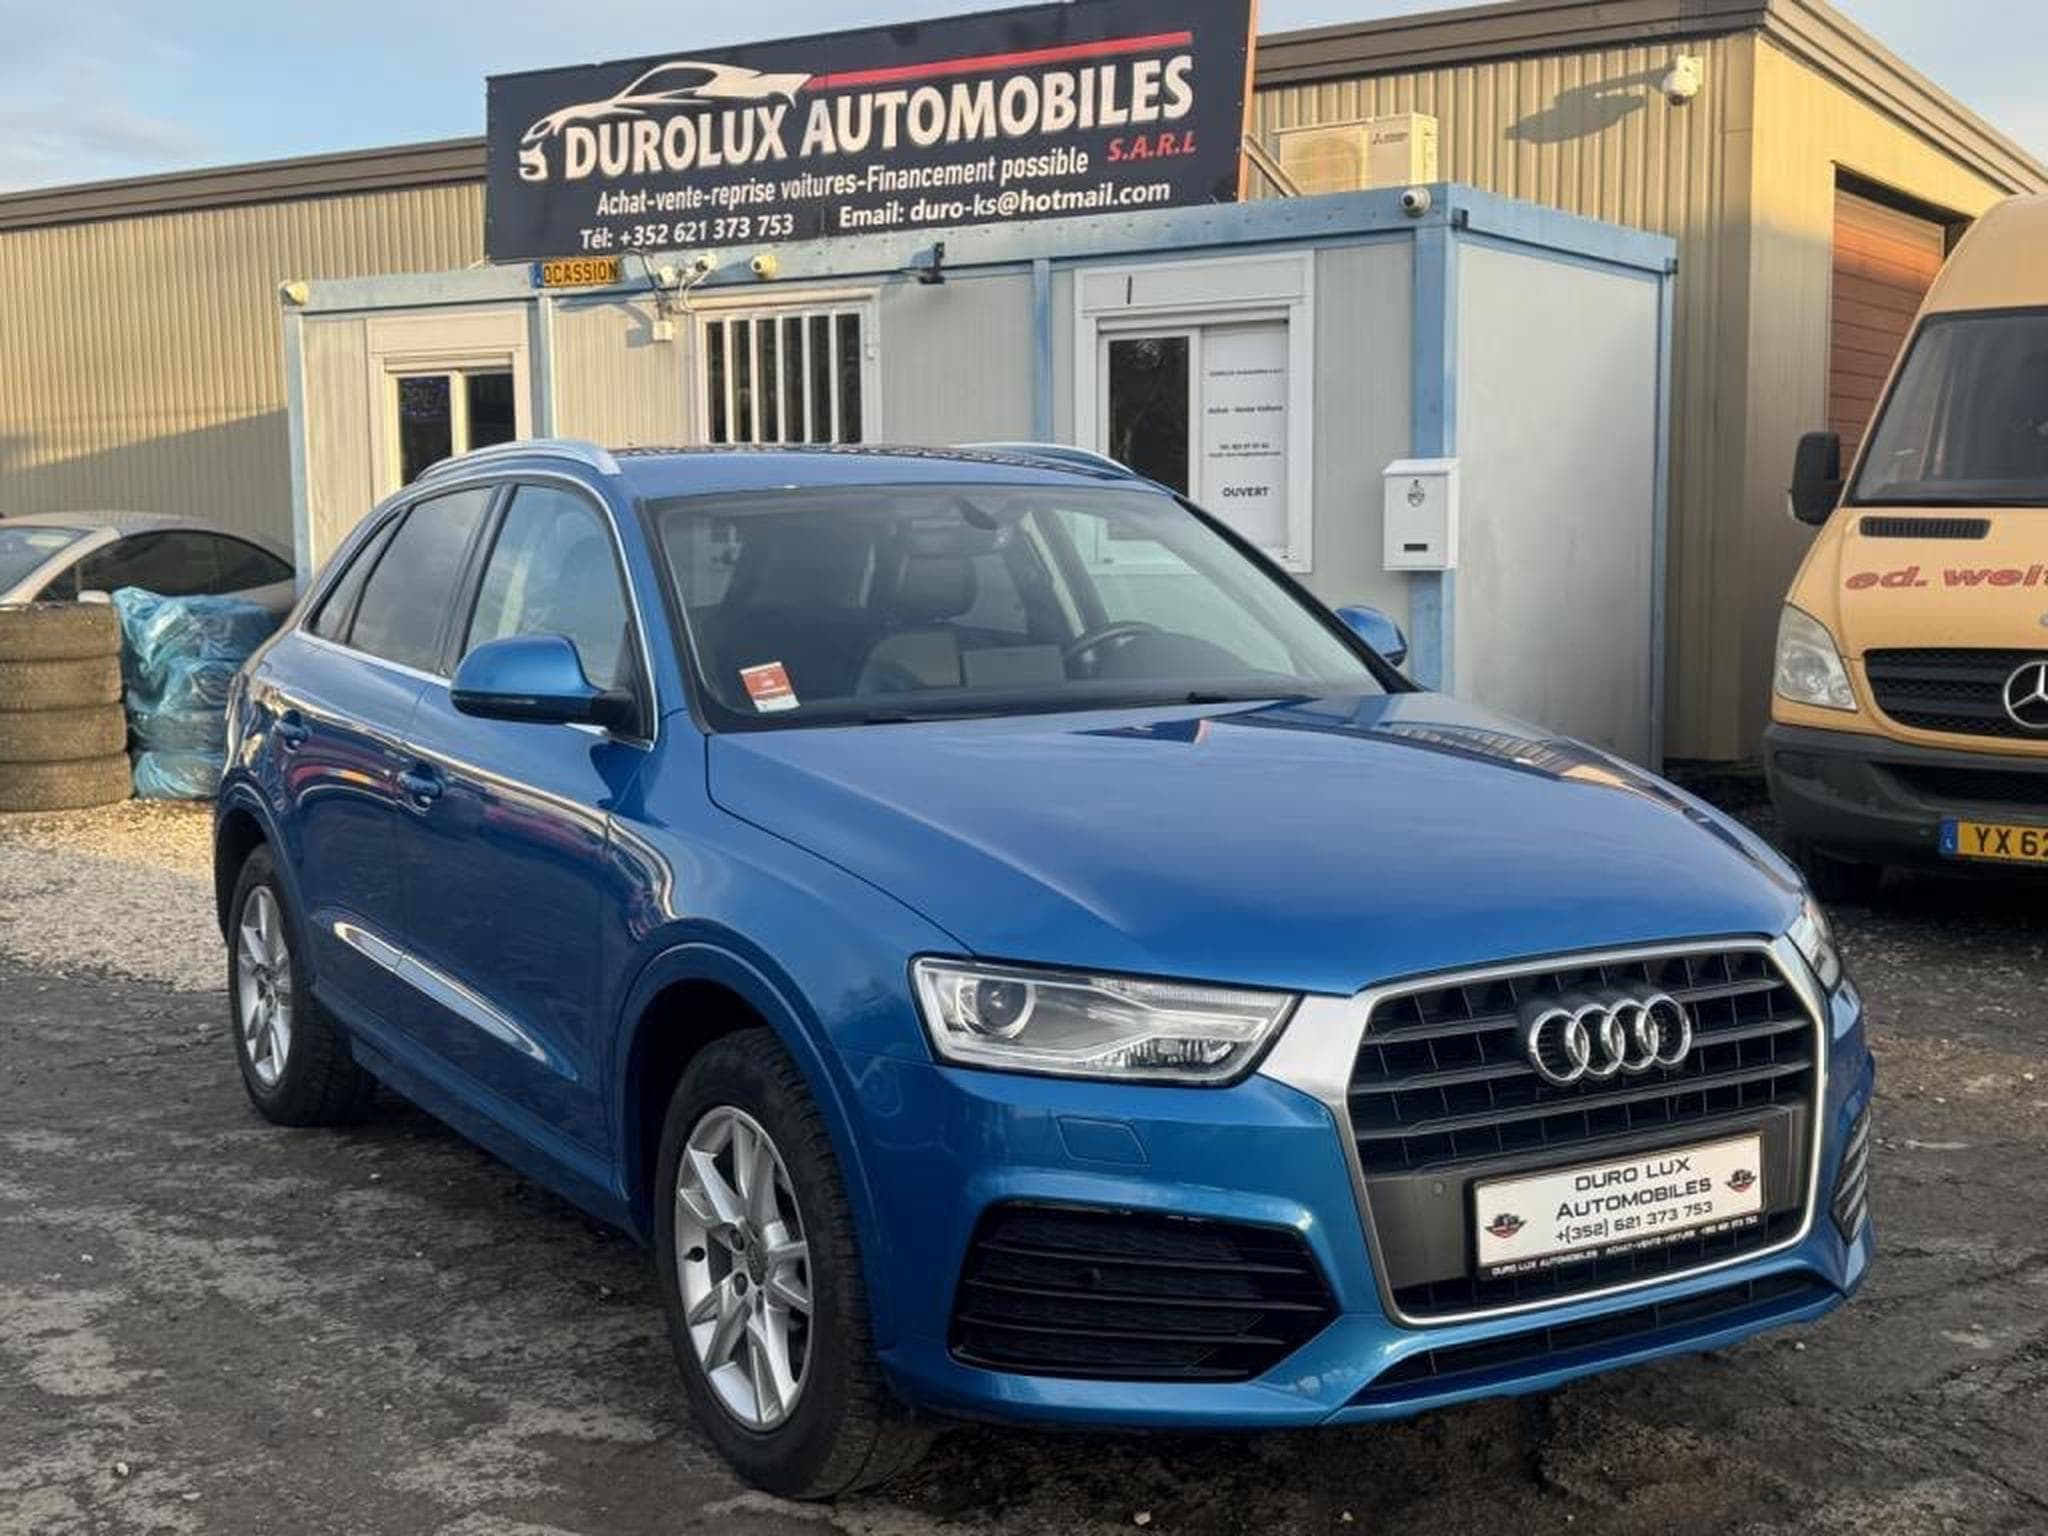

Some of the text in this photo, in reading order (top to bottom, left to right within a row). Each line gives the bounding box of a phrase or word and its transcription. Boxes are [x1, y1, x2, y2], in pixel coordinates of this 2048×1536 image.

[565, 55, 1194, 181] DUROLUX AUTOMOBILES
[1107, 131, 1196, 162] S.A.R.L
[596, 147, 1089, 217] Achat-vente-reprise voitures-Financement possible
[839, 181, 1171, 228] Email: duro-ks@hotmail.com
[580, 213, 794, 250] Tél: +352 621 373 753
[543, 259, 619, 284] OCASSION
[1222, 486, 1269, 497] OUVERT
[1975, 827, 2011, 854] YX
[1575, 1157, 1692, 1191] DURO LUX
[1556, 1177, 1712, 1220] AUTOMOBILES
[1556, 1201, 1713, 1244] +(352) 621 373 753
